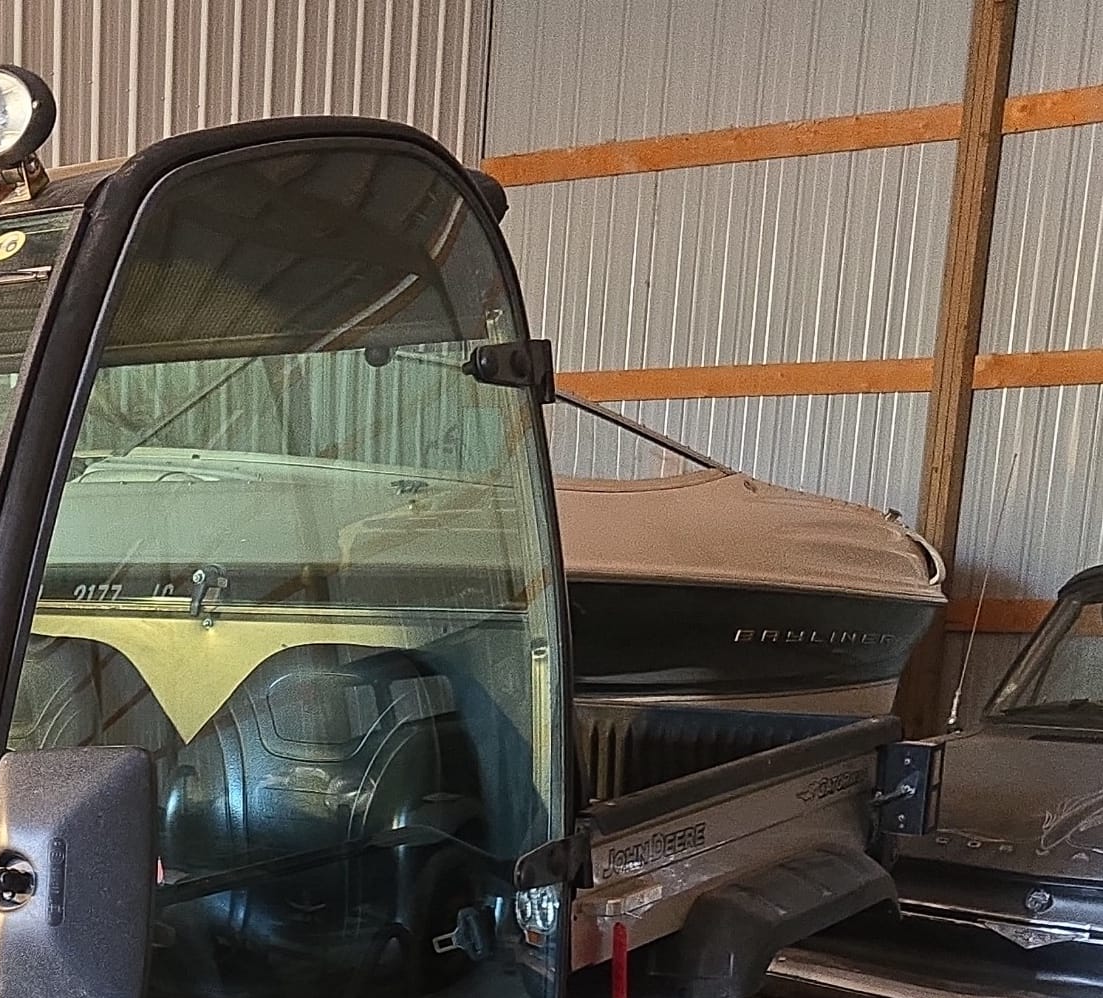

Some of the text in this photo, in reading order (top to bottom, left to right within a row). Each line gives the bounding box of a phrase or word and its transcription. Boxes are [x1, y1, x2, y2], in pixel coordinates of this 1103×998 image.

[734, 629, 897, 645] BAYLINER
[603, 822, 706, 879] JOHN DEERE
